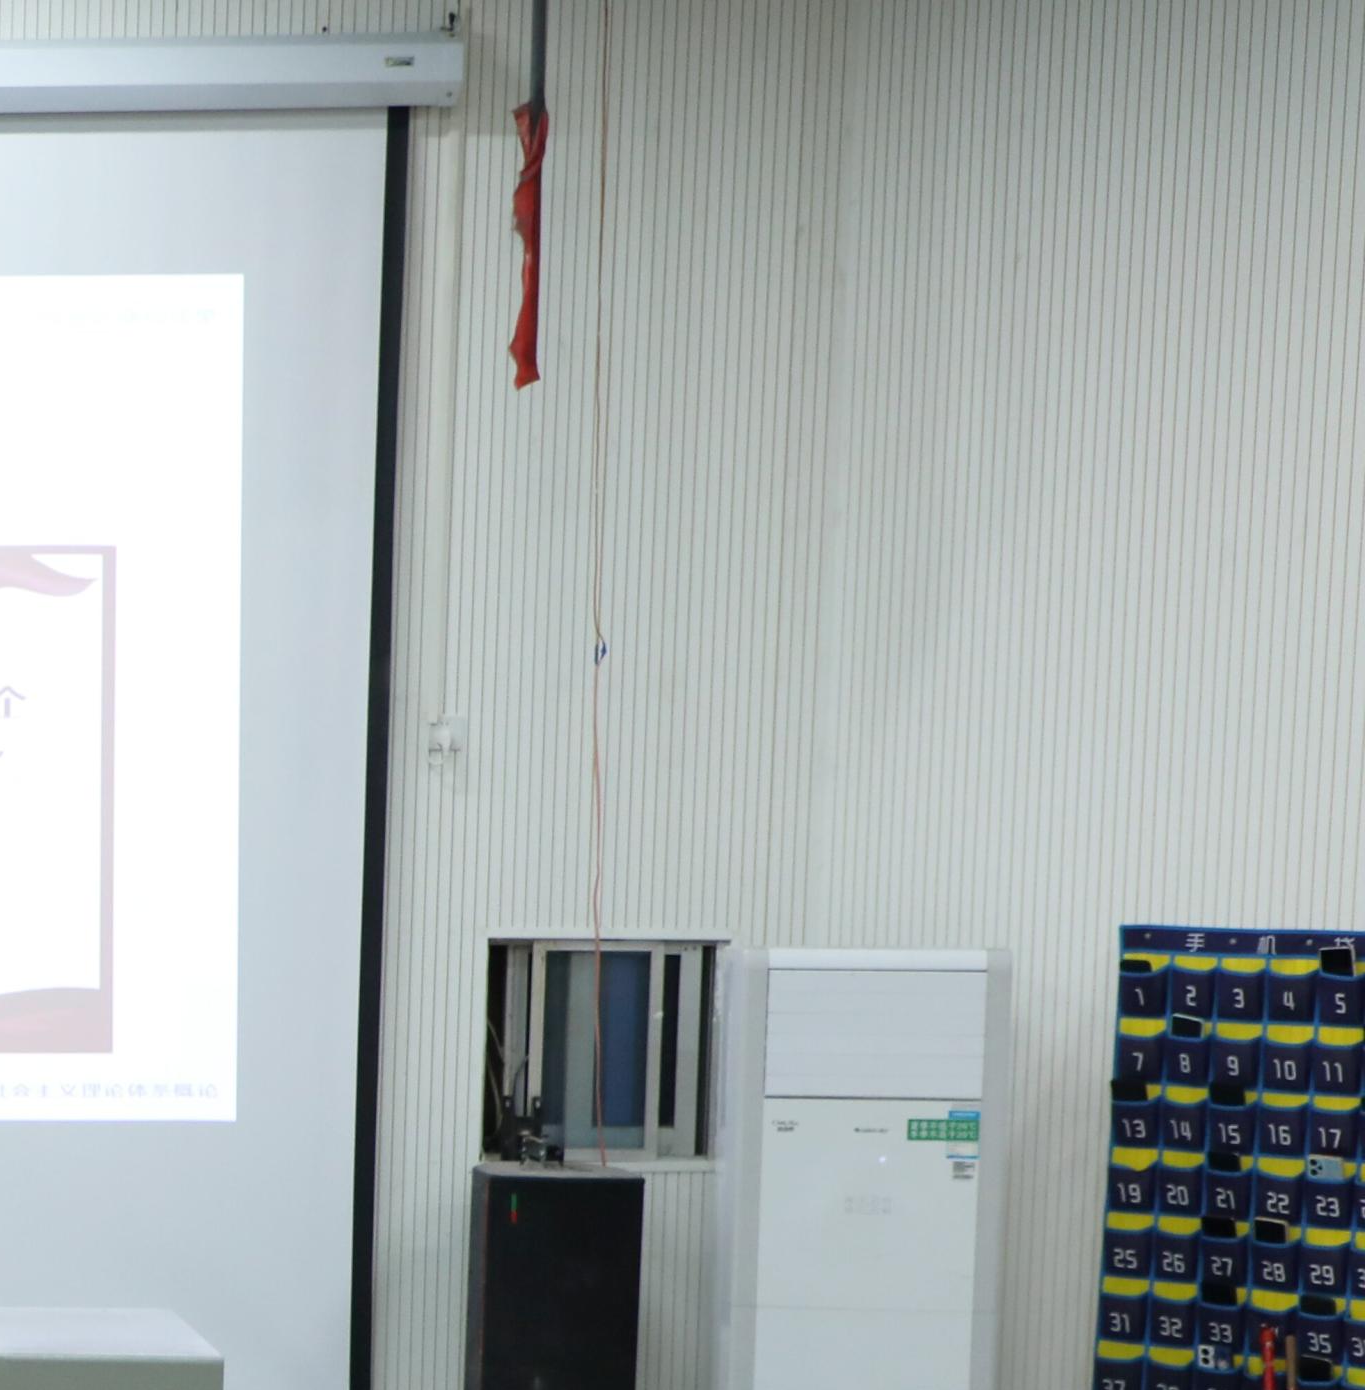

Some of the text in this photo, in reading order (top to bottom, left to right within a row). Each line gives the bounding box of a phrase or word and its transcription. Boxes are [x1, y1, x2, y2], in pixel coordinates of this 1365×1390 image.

[1134, 985, 1347, 1014] 1 2 3 4 5
[1132, 1051, 1343, 1083] 7 8 9 10 11
[1122, 1118, 1342, 1149] 13 14 15 16 17
[1117, 1183, 1142, 1204] 19
[1166, 1184, 1189, 1206] 20
[1215, 1187, 1235, 1209] 21
[1266, 1191, 1290, 1214] 22
[1315, 1195, 1340, 1218] 23
[1113, 1248, 1138, 1269] 25
[1162, 1251, 1185, 1273] 26
[1210, 1256, 1233, 1276] 27
[1262, 1260, 1286, 1282] 28
[1309, 1263, 1335, 1286] 29
[1109, 1312, 1130, 1333] 31
[1159, 1315, 1183, 1338] 32
[1208, 1321, 1233, 1344] 33
[1307, 1332, 1332, 1354] 35
